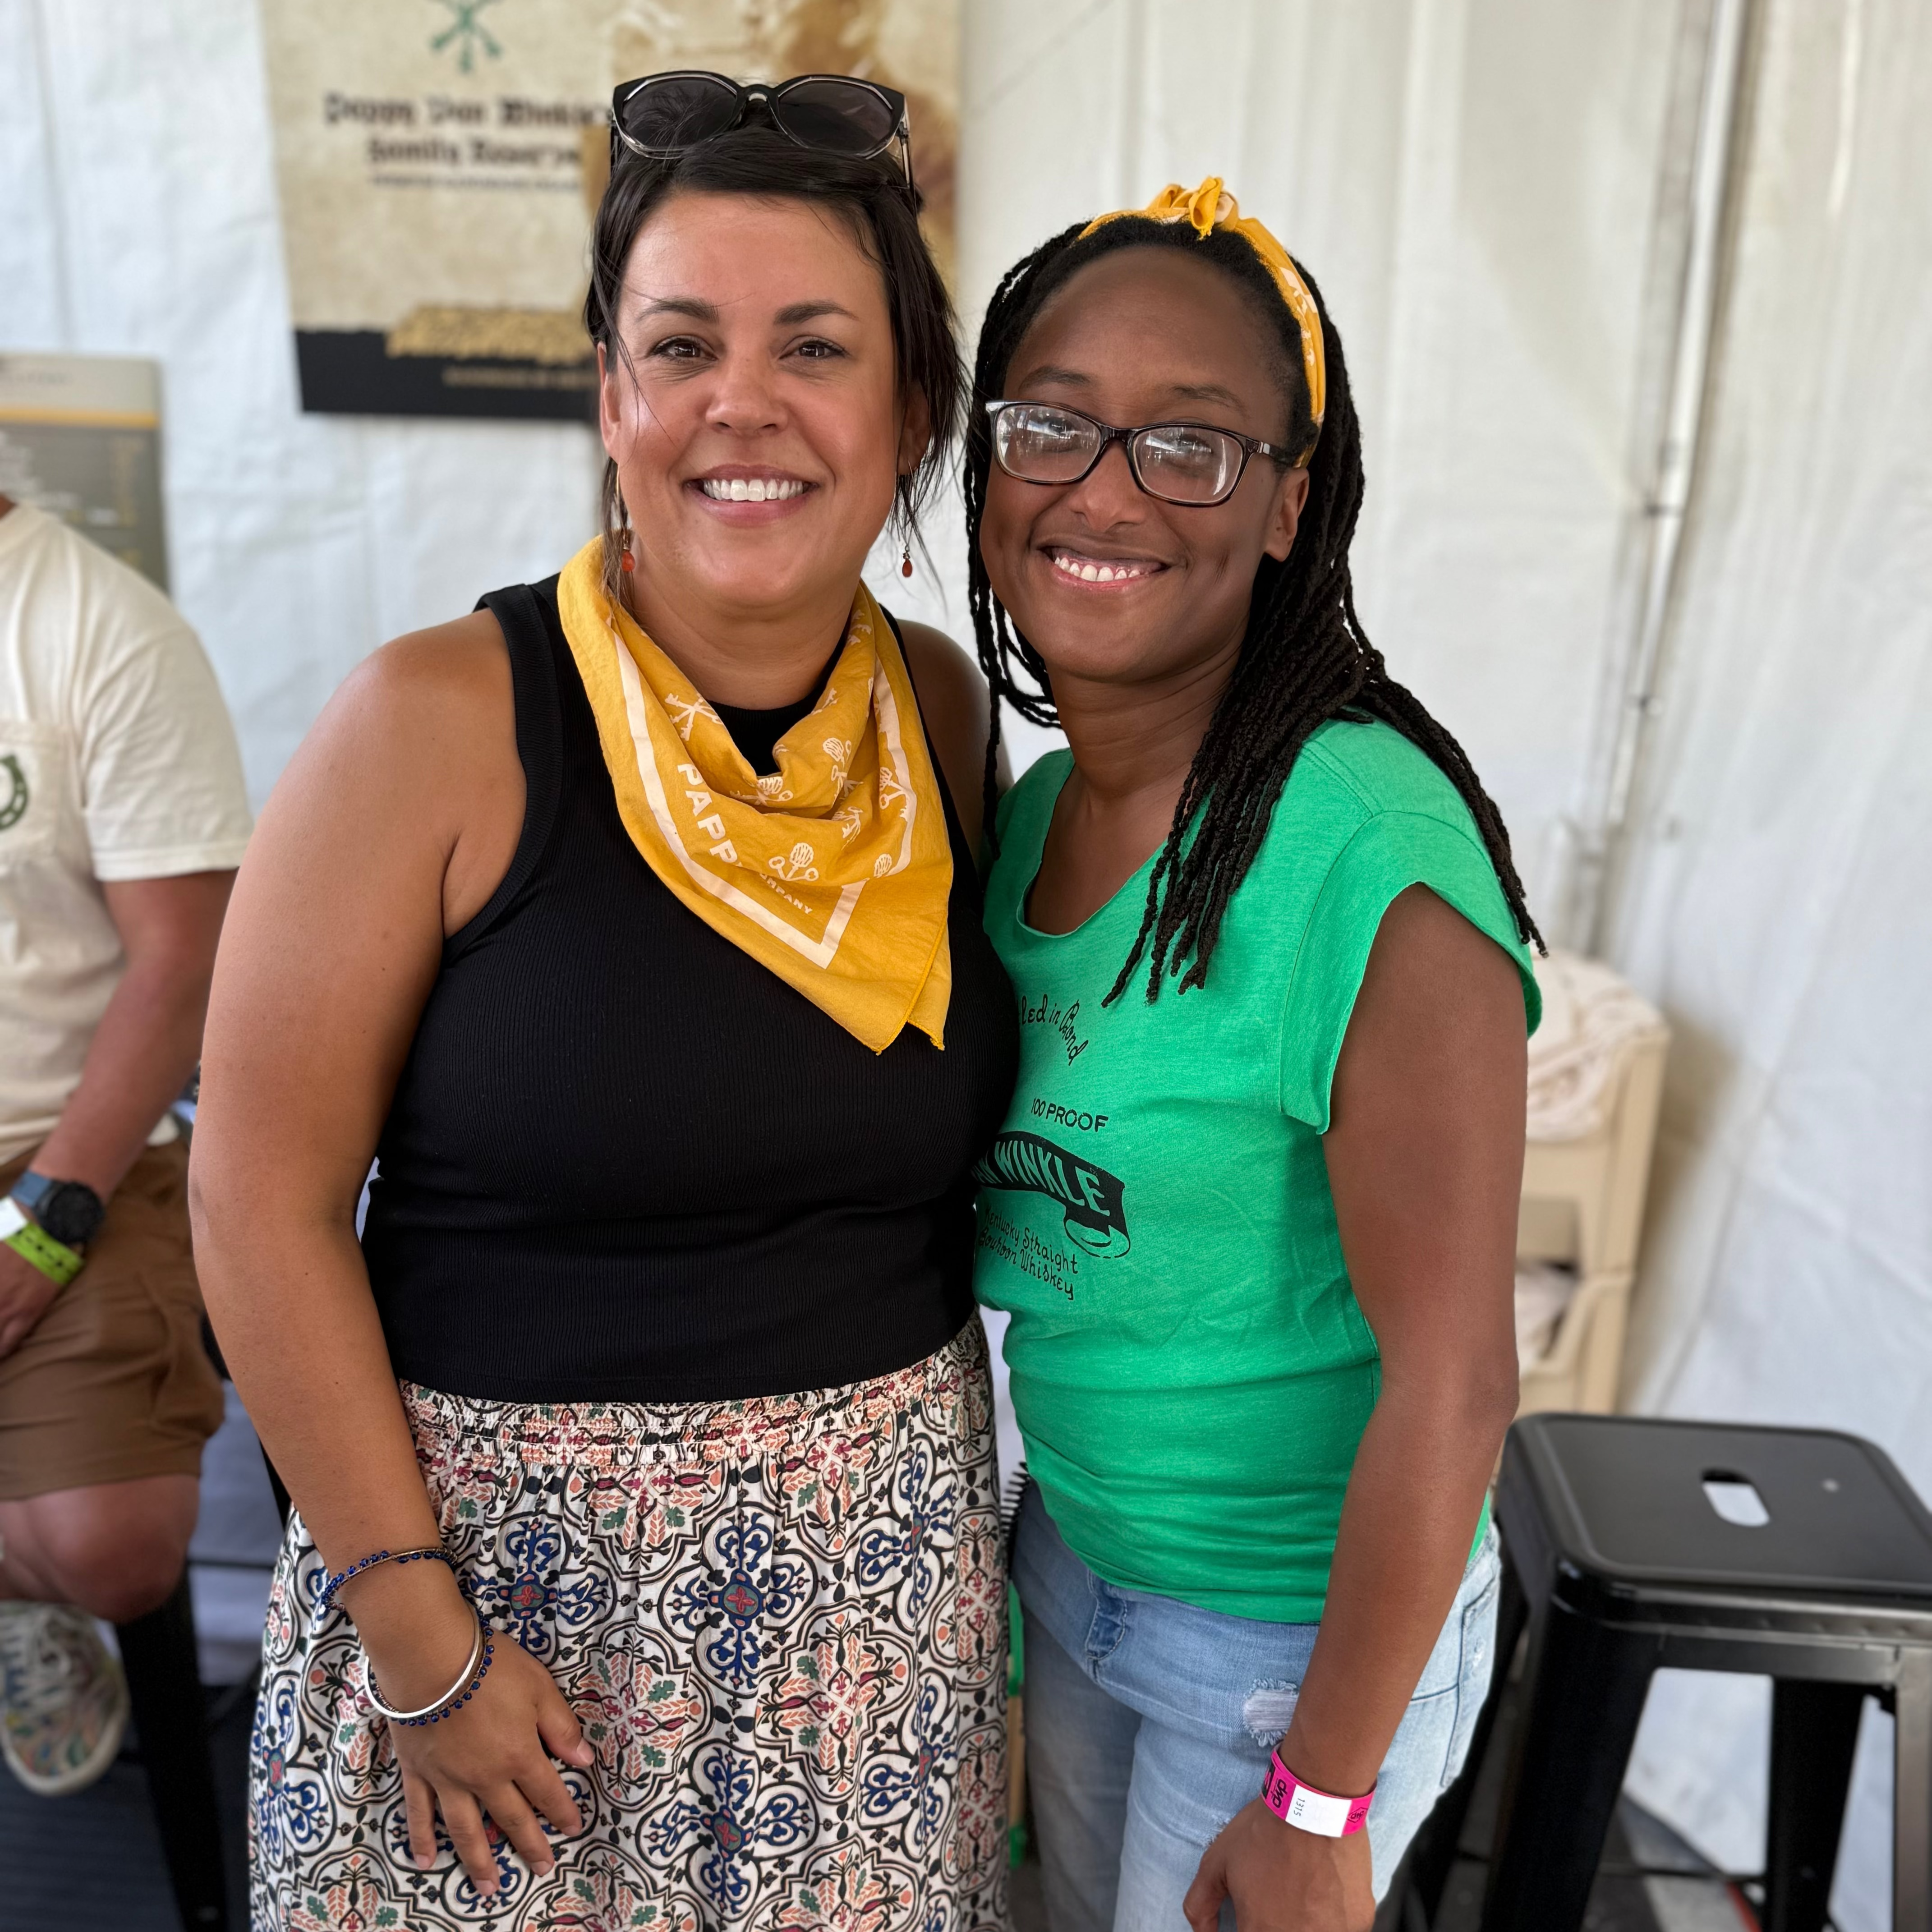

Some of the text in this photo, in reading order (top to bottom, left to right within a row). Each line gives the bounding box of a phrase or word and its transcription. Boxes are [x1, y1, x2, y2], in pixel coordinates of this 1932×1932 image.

[677, 764, 743, 867] PAPP
[1021, 994, 1048, 1025] led
[1049, 1002, 1061, 1025] in
[1031, 1098, 1109, 1132] 100 PROOF
[994, 1140, 1110, 1216] WINKLE
[979, 1227, 1074, 1301] Bourbon Whiskey
[1022, 1227, 1078, 1274] Straight
[1293, 1797, 1306, 1817] 1315
